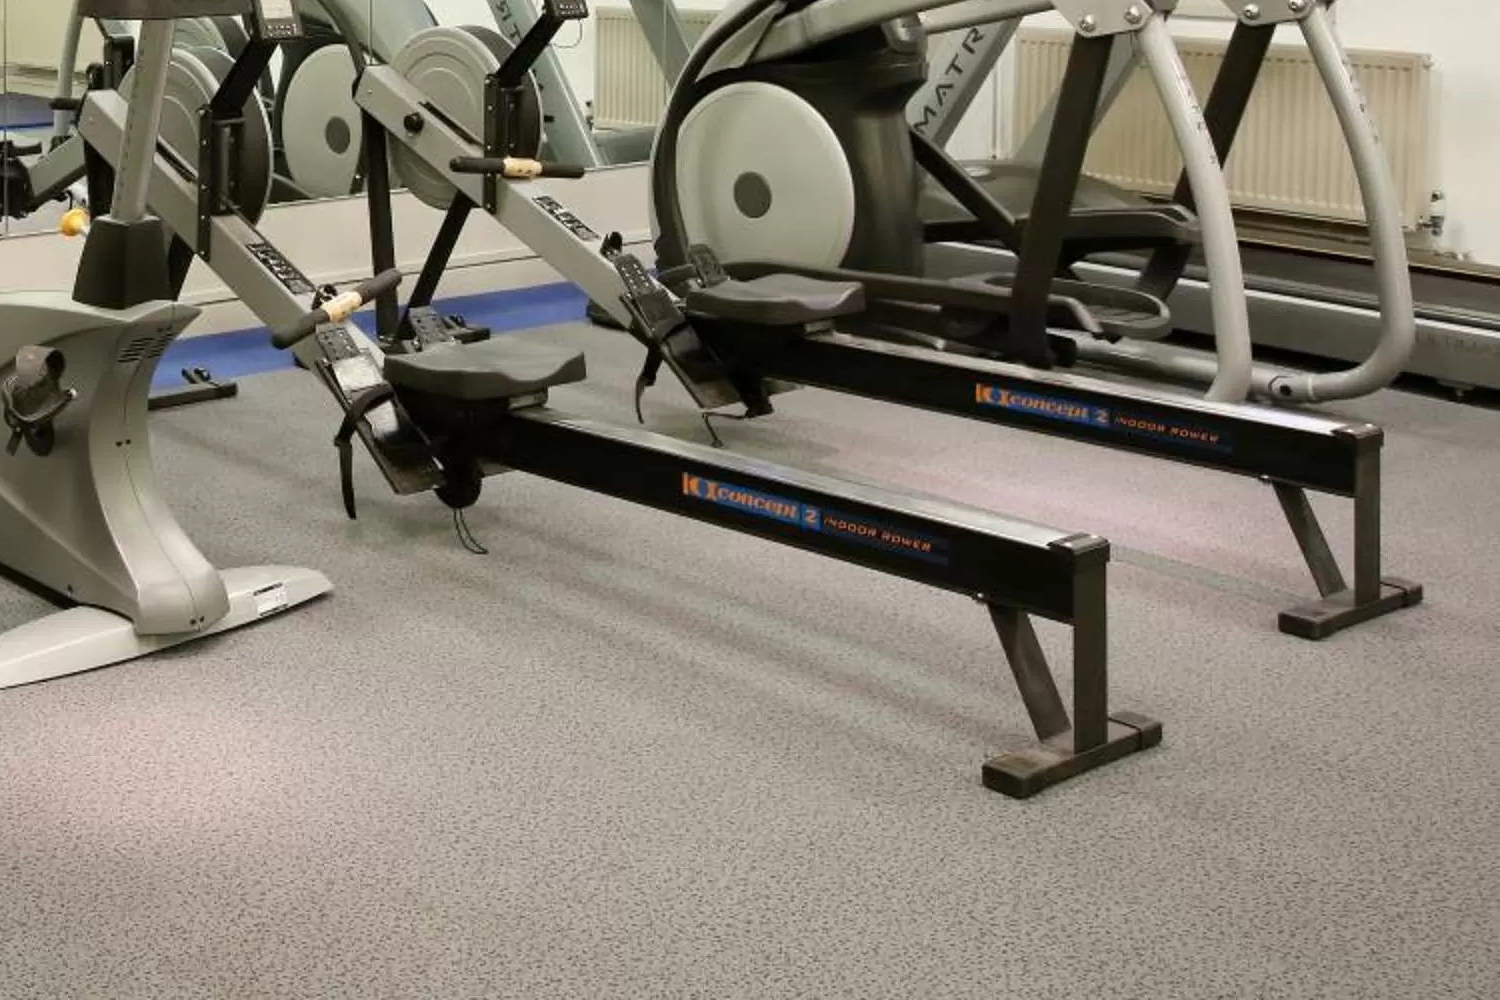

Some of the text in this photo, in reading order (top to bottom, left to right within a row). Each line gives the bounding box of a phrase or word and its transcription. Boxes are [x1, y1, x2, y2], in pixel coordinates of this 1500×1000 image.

[913, 26, 985, 135] MATR
[1095, 409, 1109, 423] 2
[1114, 414, 1166, 433] INDOOR
[1171, 425, 1221, 443] ROWER
[804, 507, 818, 525] 2
[823, 515, 878, 538] INDOOR
[881, 531, 933, 552] ROWER
